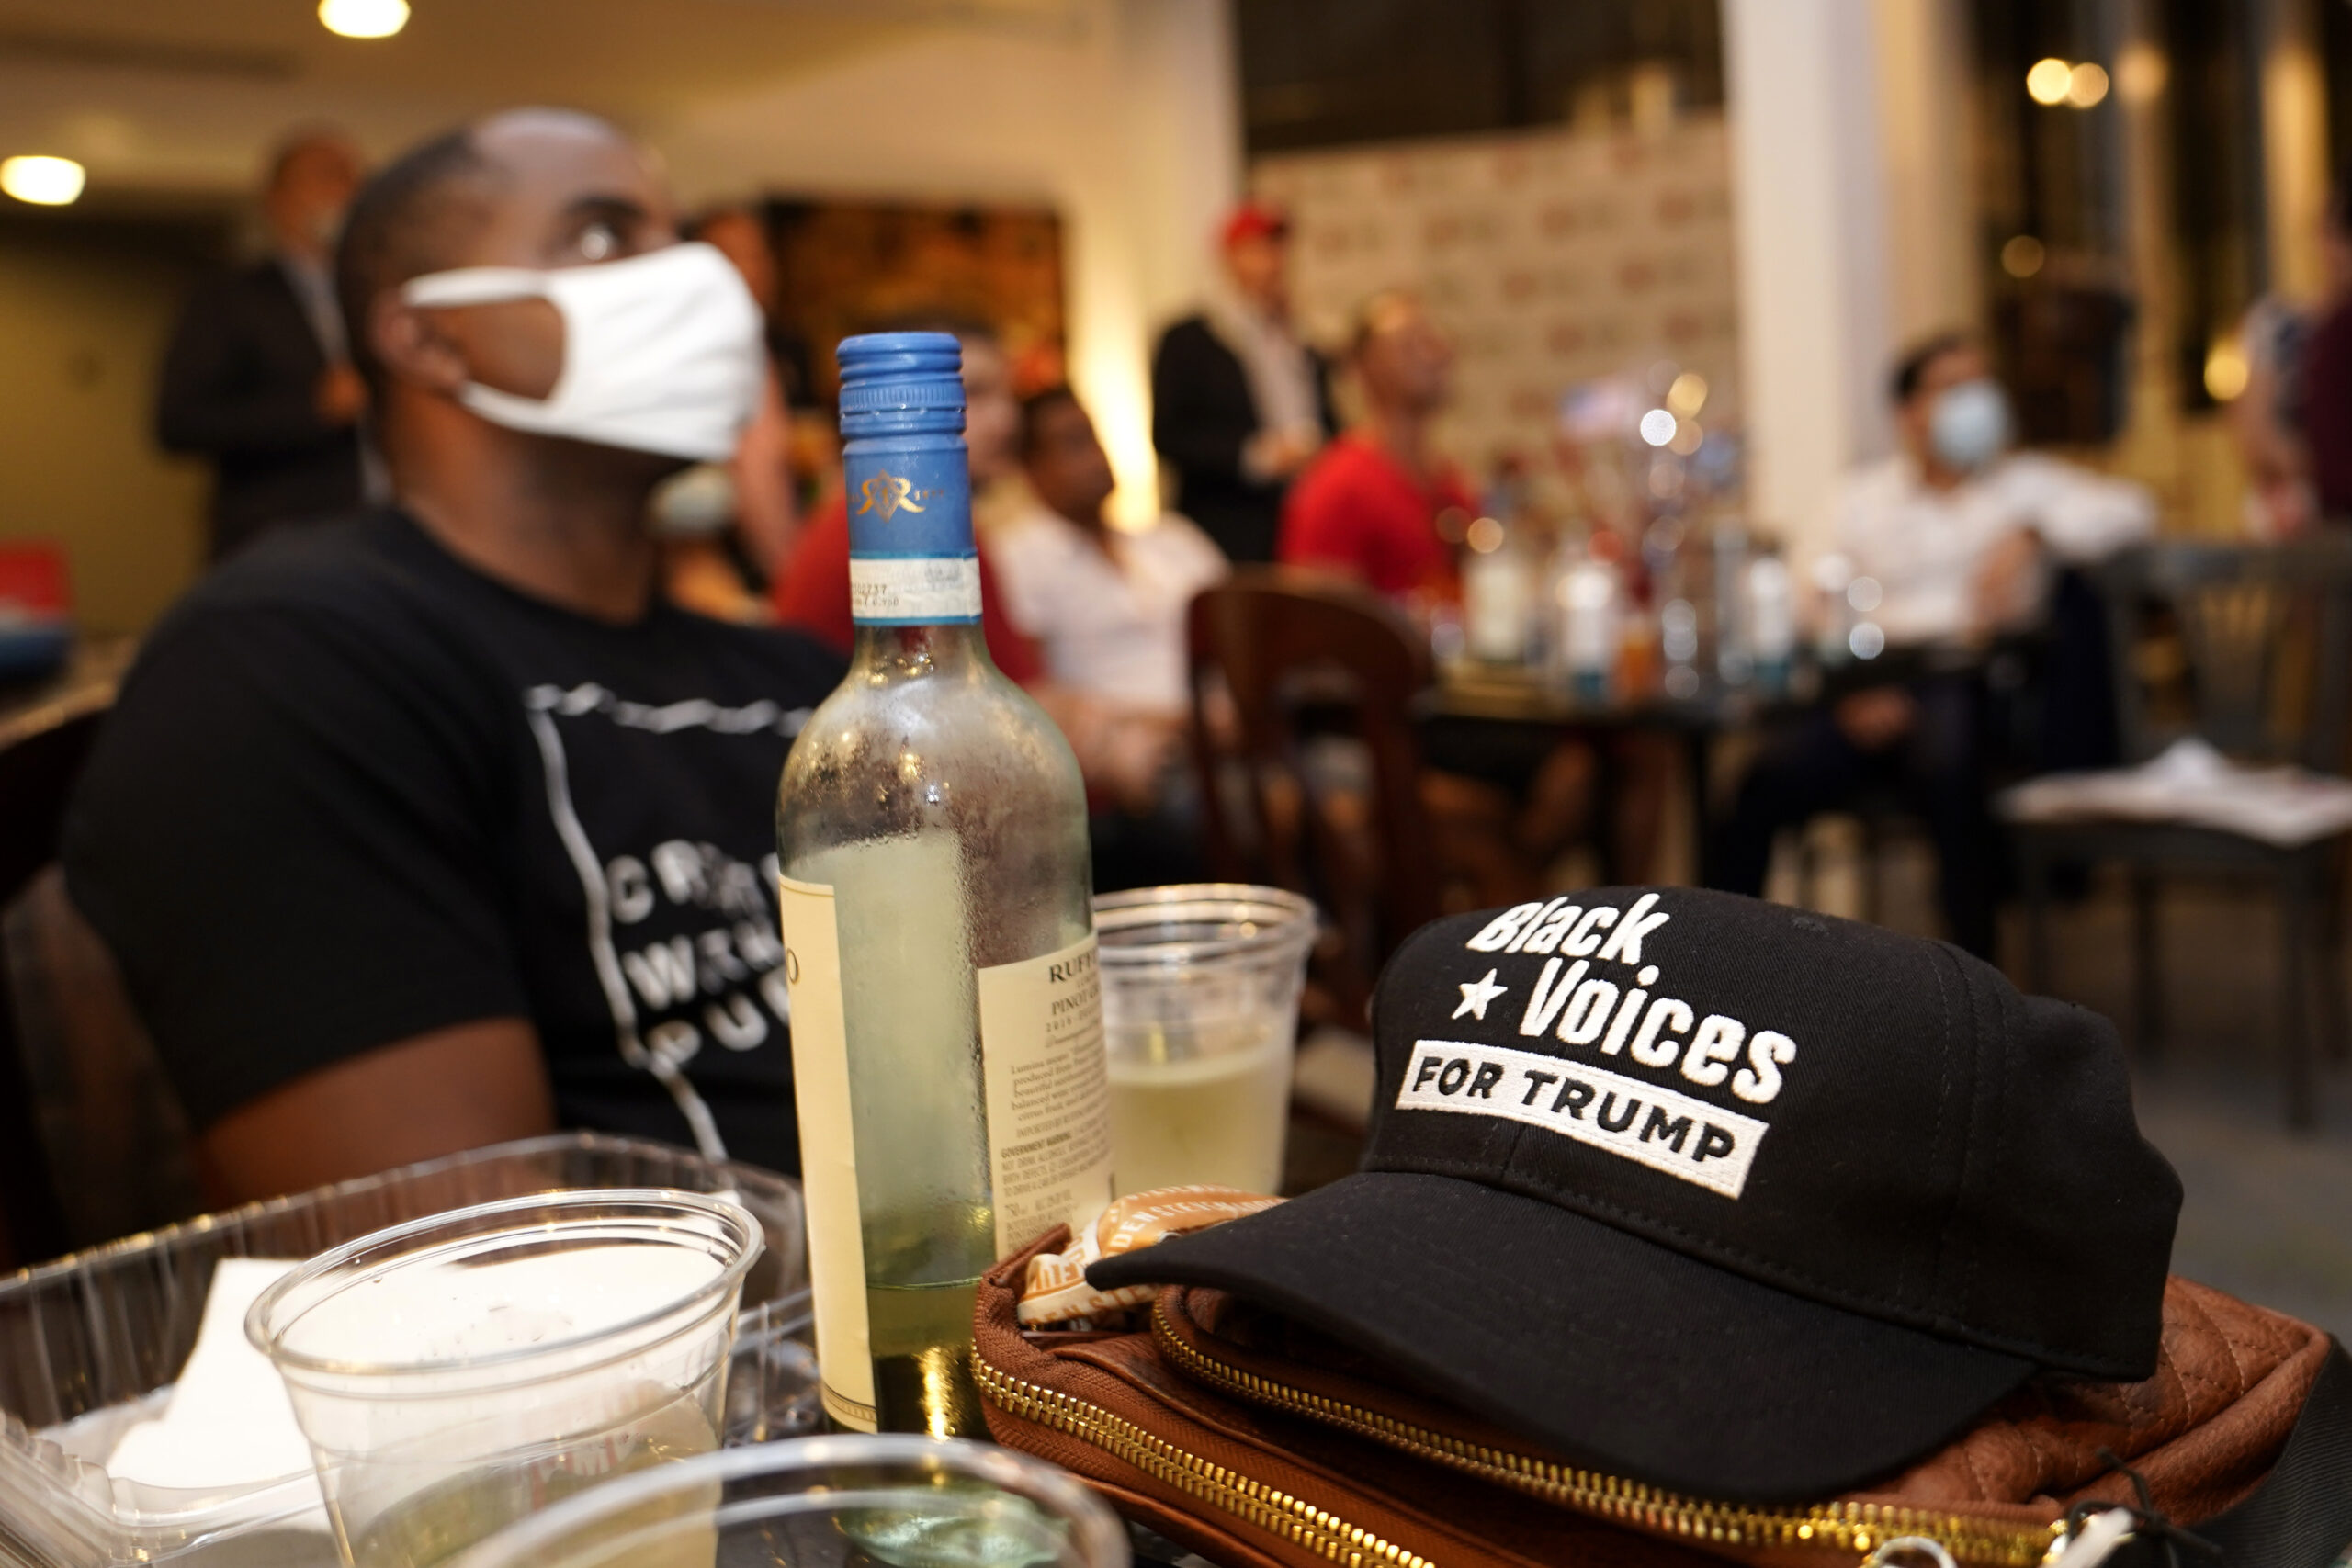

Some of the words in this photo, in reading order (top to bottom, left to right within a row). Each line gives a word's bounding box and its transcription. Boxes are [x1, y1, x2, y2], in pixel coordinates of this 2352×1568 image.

[1465, 892, 1670, 965] Black
[1051, 989, 1089, 1016] PINOT
[1520, 957, 1797, 1104] Voices
[1412, 1056, 1505, 1100] FOR
[1521, 1069, 1736, 1163] TRUMP
